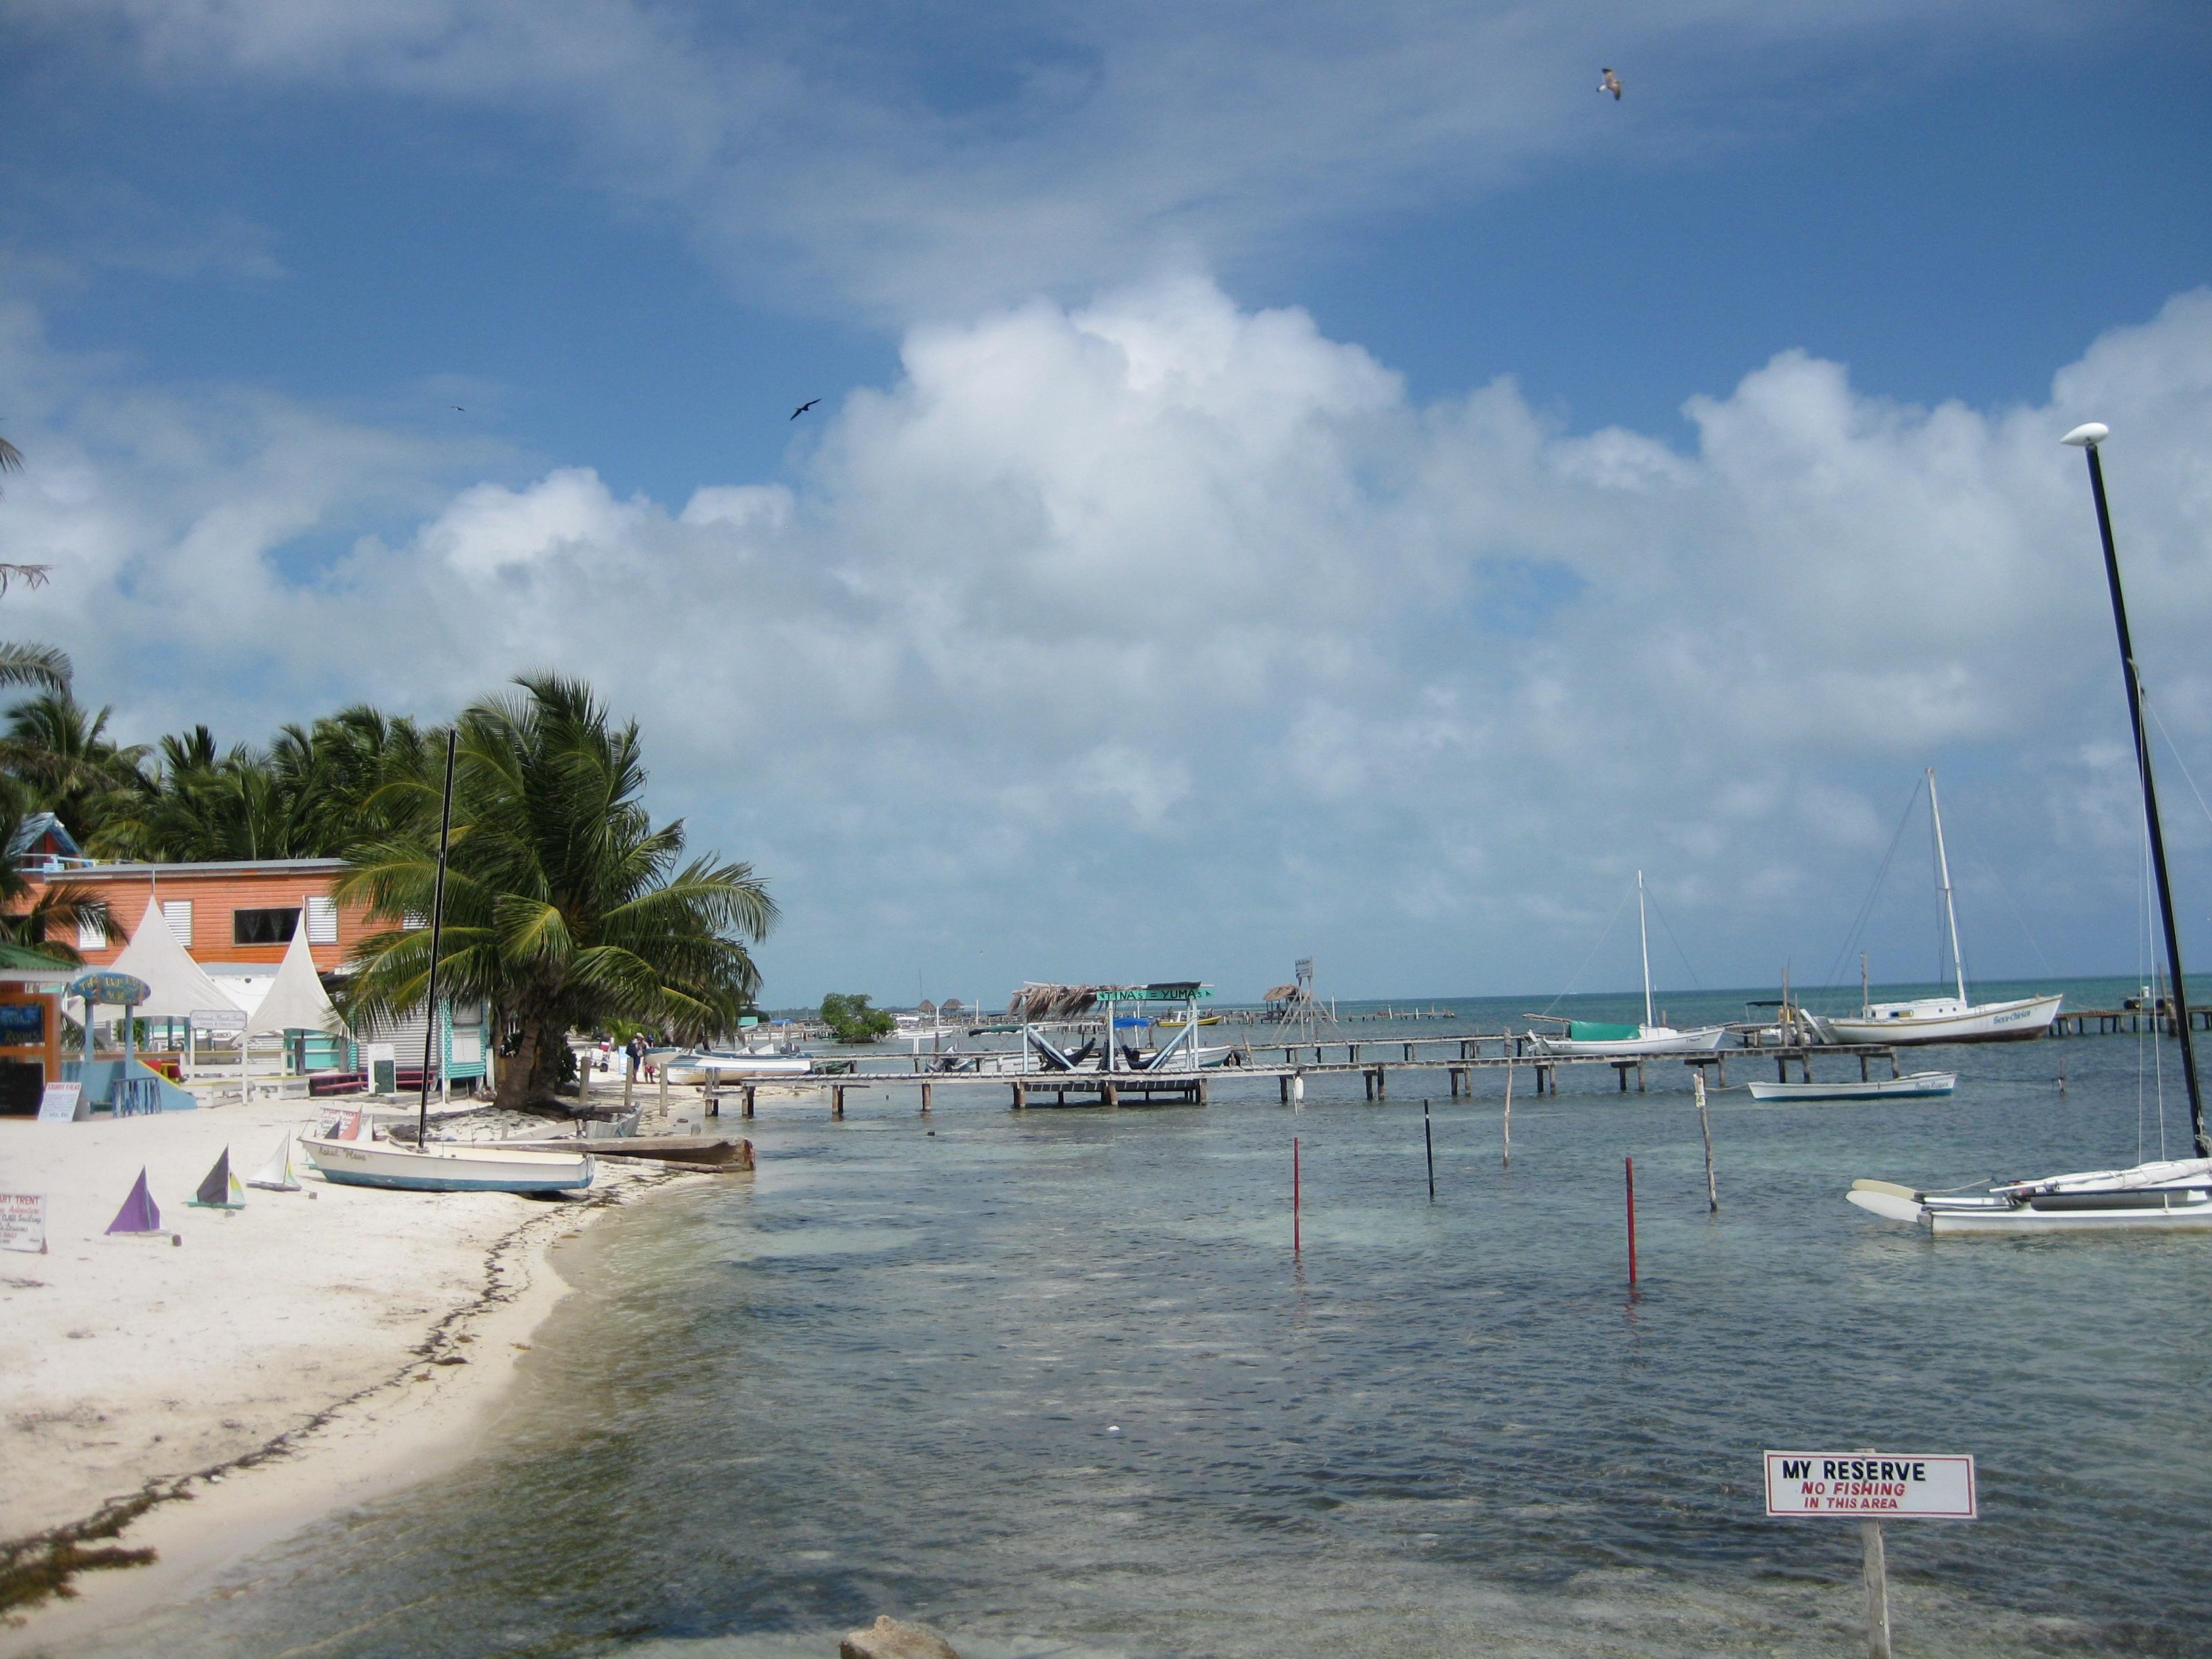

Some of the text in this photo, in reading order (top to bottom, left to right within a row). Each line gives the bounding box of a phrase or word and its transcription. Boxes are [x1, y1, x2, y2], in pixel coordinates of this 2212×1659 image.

[1162, 989, 1202, 999] YUMA's
[16, 1195, 39, 1205] TRENT
[1782, 1460, 1926, 1481] MY RESERVE
[1800, 1481, 1906, 1496] NO FISHING
[1803, 1496, 1898, 1509] IN THIS AREA
